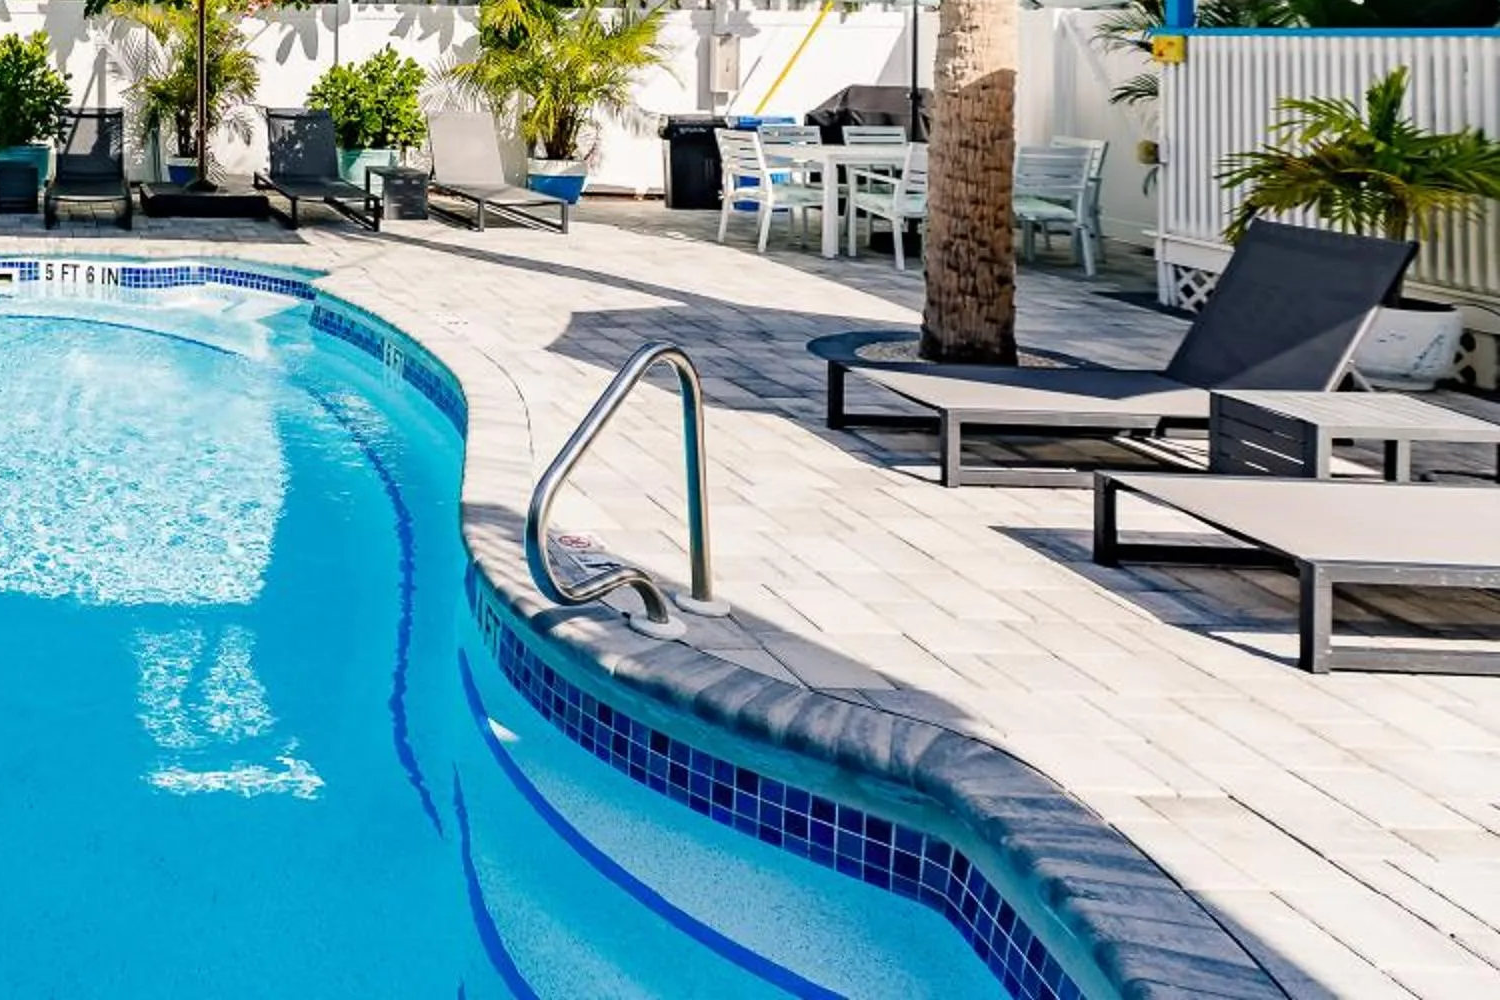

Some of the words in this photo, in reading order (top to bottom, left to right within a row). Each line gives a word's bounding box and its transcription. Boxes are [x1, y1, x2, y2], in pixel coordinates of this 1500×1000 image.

[45, 263, 54, 281] 5
[61, 263, 80, 283] FT
[85, 265, 95, 284] 6
[101, 268, 119, 286] IN
[484, 604, 501, 660] FT
